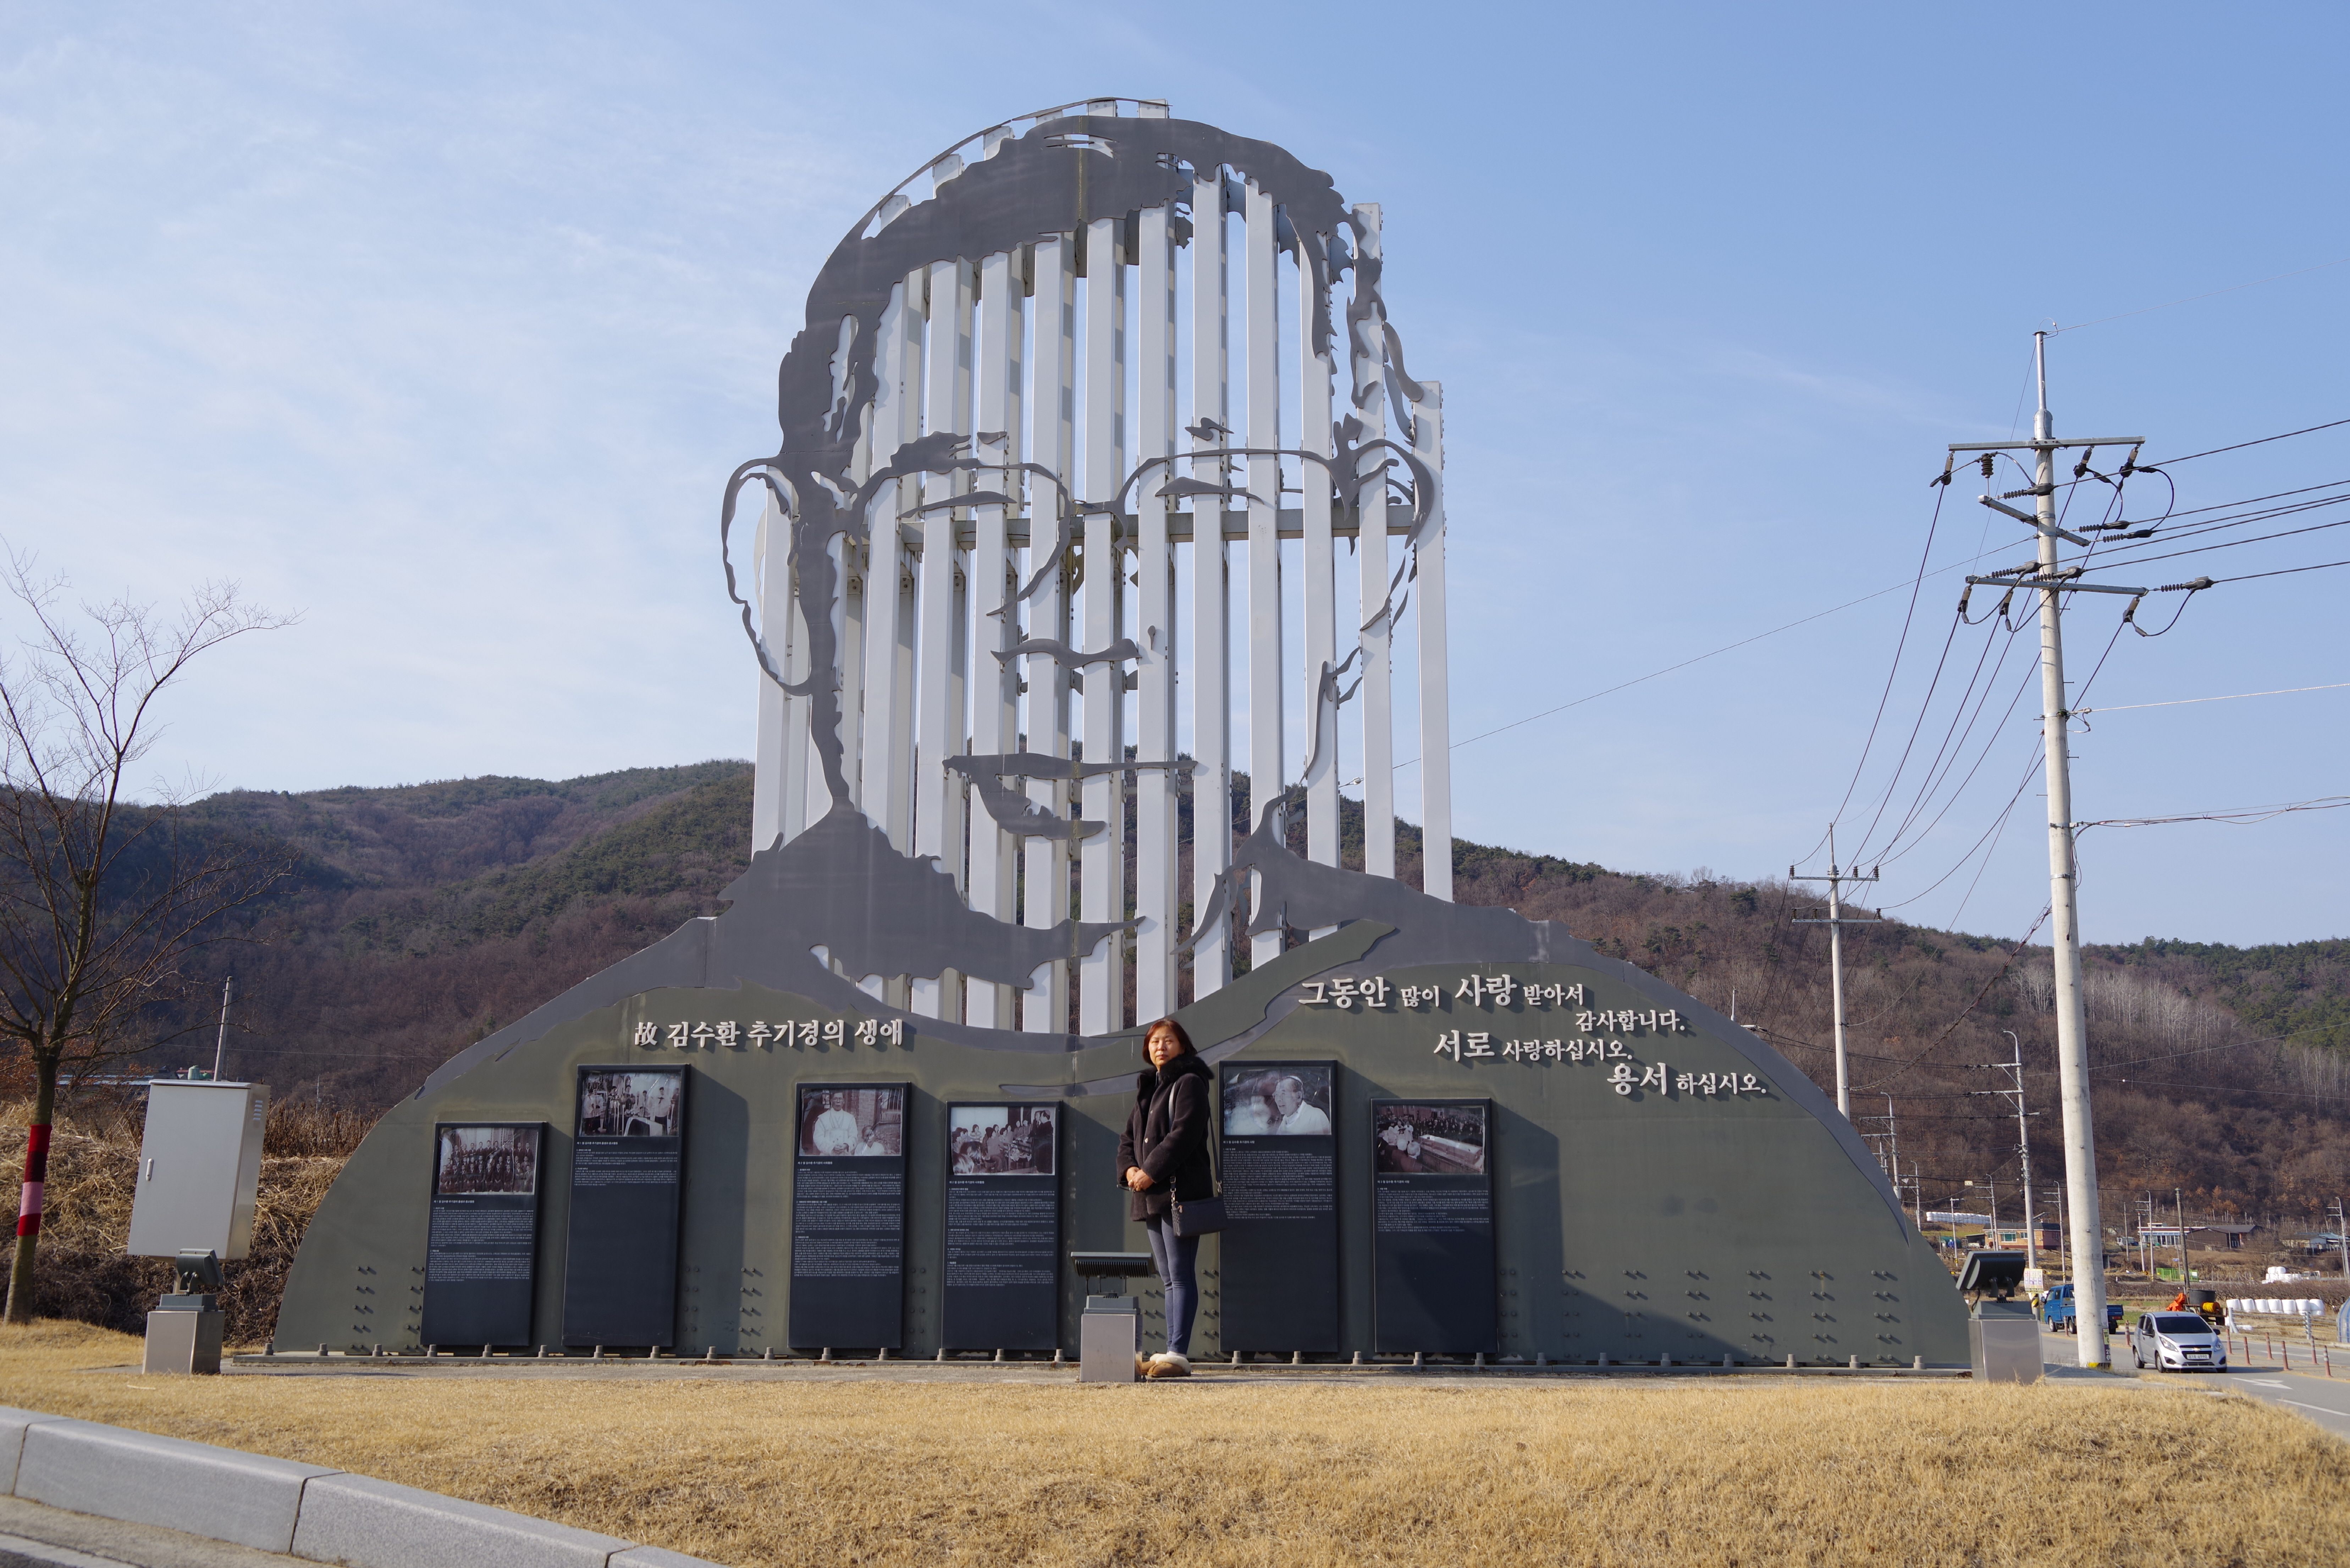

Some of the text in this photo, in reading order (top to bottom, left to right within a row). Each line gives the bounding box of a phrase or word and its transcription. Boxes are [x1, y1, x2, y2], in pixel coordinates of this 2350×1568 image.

[1298, 974, 1583, 1009] 그동안 많이 사랑 받아서
[634, 1019, 903, 1048] 故 김수환 추기경의 생애
[1575, 1009, 1685, 1032] 감사합니다.
[1433, 1030, 1633, 1062] 서로 사랑하십시오.
[1607, 1062, 1766, 1096] 용서 하십시오.
